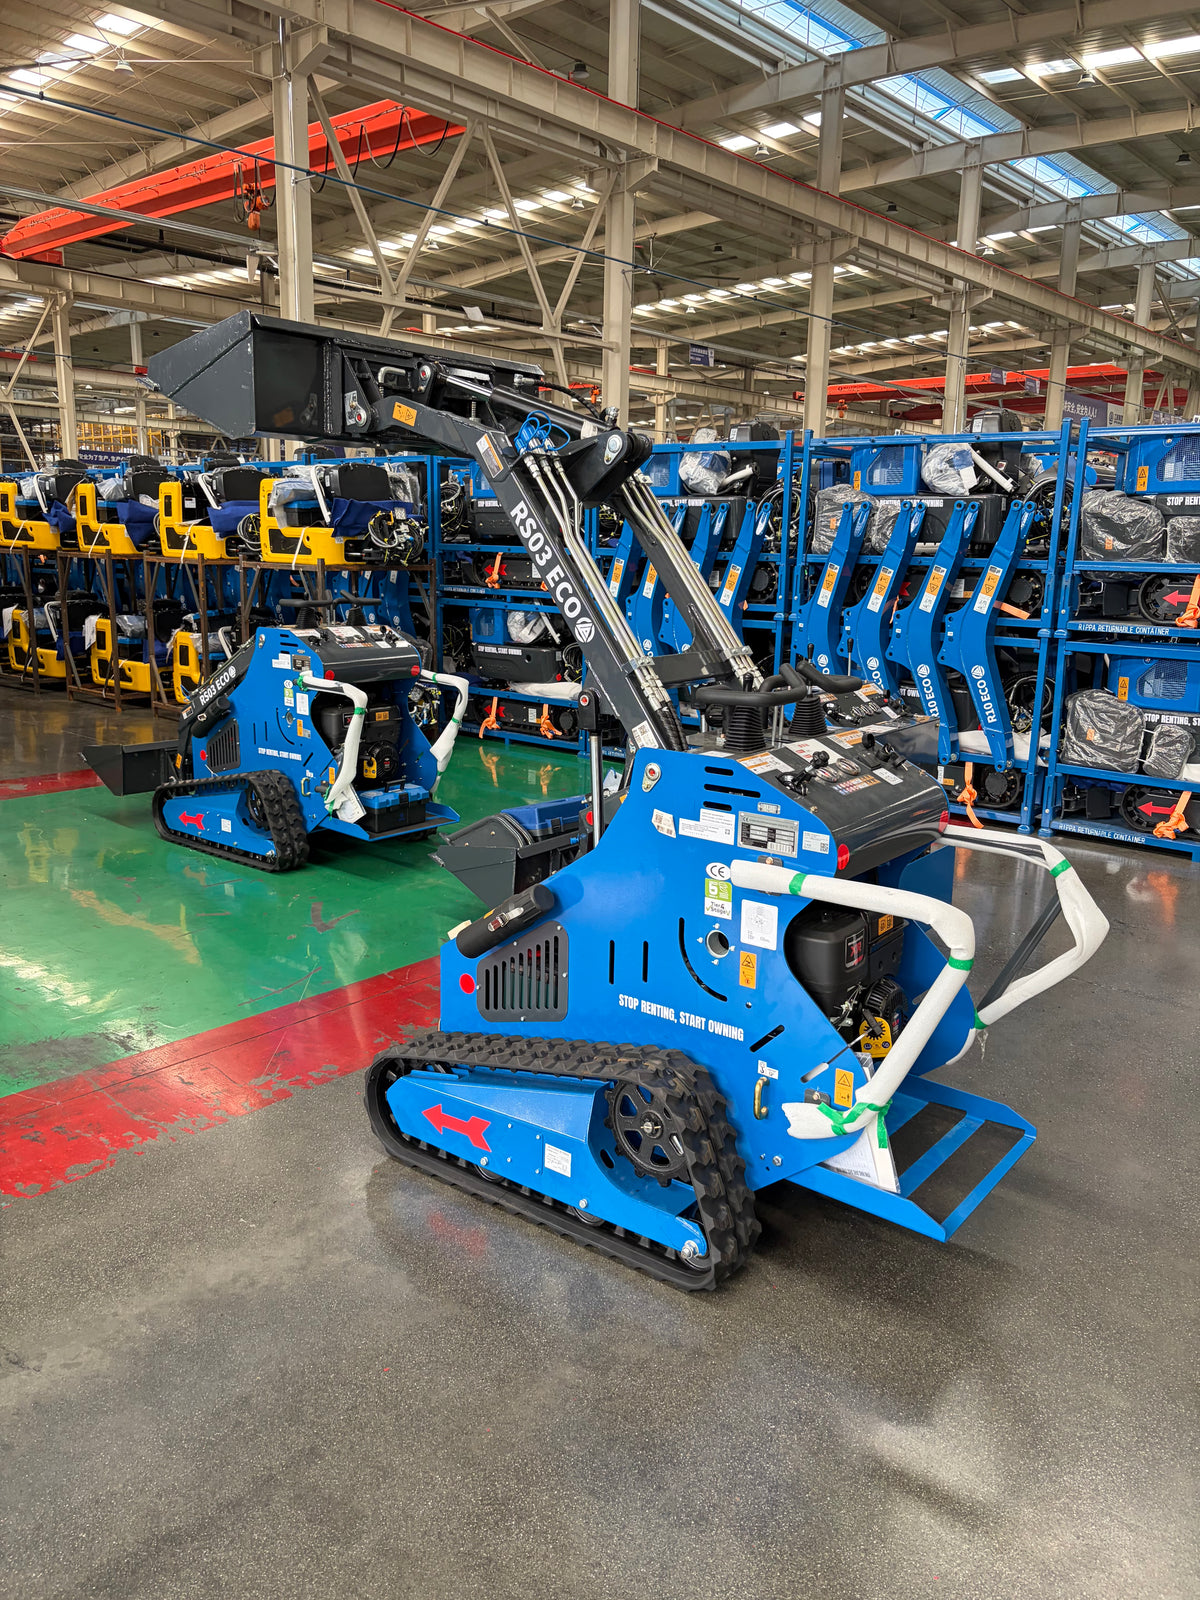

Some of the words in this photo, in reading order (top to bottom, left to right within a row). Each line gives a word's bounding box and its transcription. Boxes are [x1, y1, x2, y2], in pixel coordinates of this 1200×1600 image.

[1166, 496, 1184, 506] STOP
[510, 501, 553, 567] RS03
[545, 565, 582, 618] ECO
[1078, 623, 1096, 632] RIPPA
[1097, 624, 1133, 633] RETURNABLE
[1135, 626, 1170, 635] CONTAINER
[200, 685, 217, 706] RS03
[216, 672, 230, 691] ECO
[922, 678, 935, 700] ECO
[977, 679, 991, 702] ECO
[983, 702, 997, 724] R10
[1144, 712, 1160, 723] STOP
[1161, 715, 1191, 726] RENTING,
[1058, 824, 1076, 832] RIPPA
[1113, 832, 1146, 844] CONTAINER
[710, 865, 725, 878] CE
[618, 994, 639, 1010] STOP
[640, 1000, 678, 1024] RENTING,
[679, 1011, 707, 1030] START
[708, 1020, 744, 1041] OWNING
